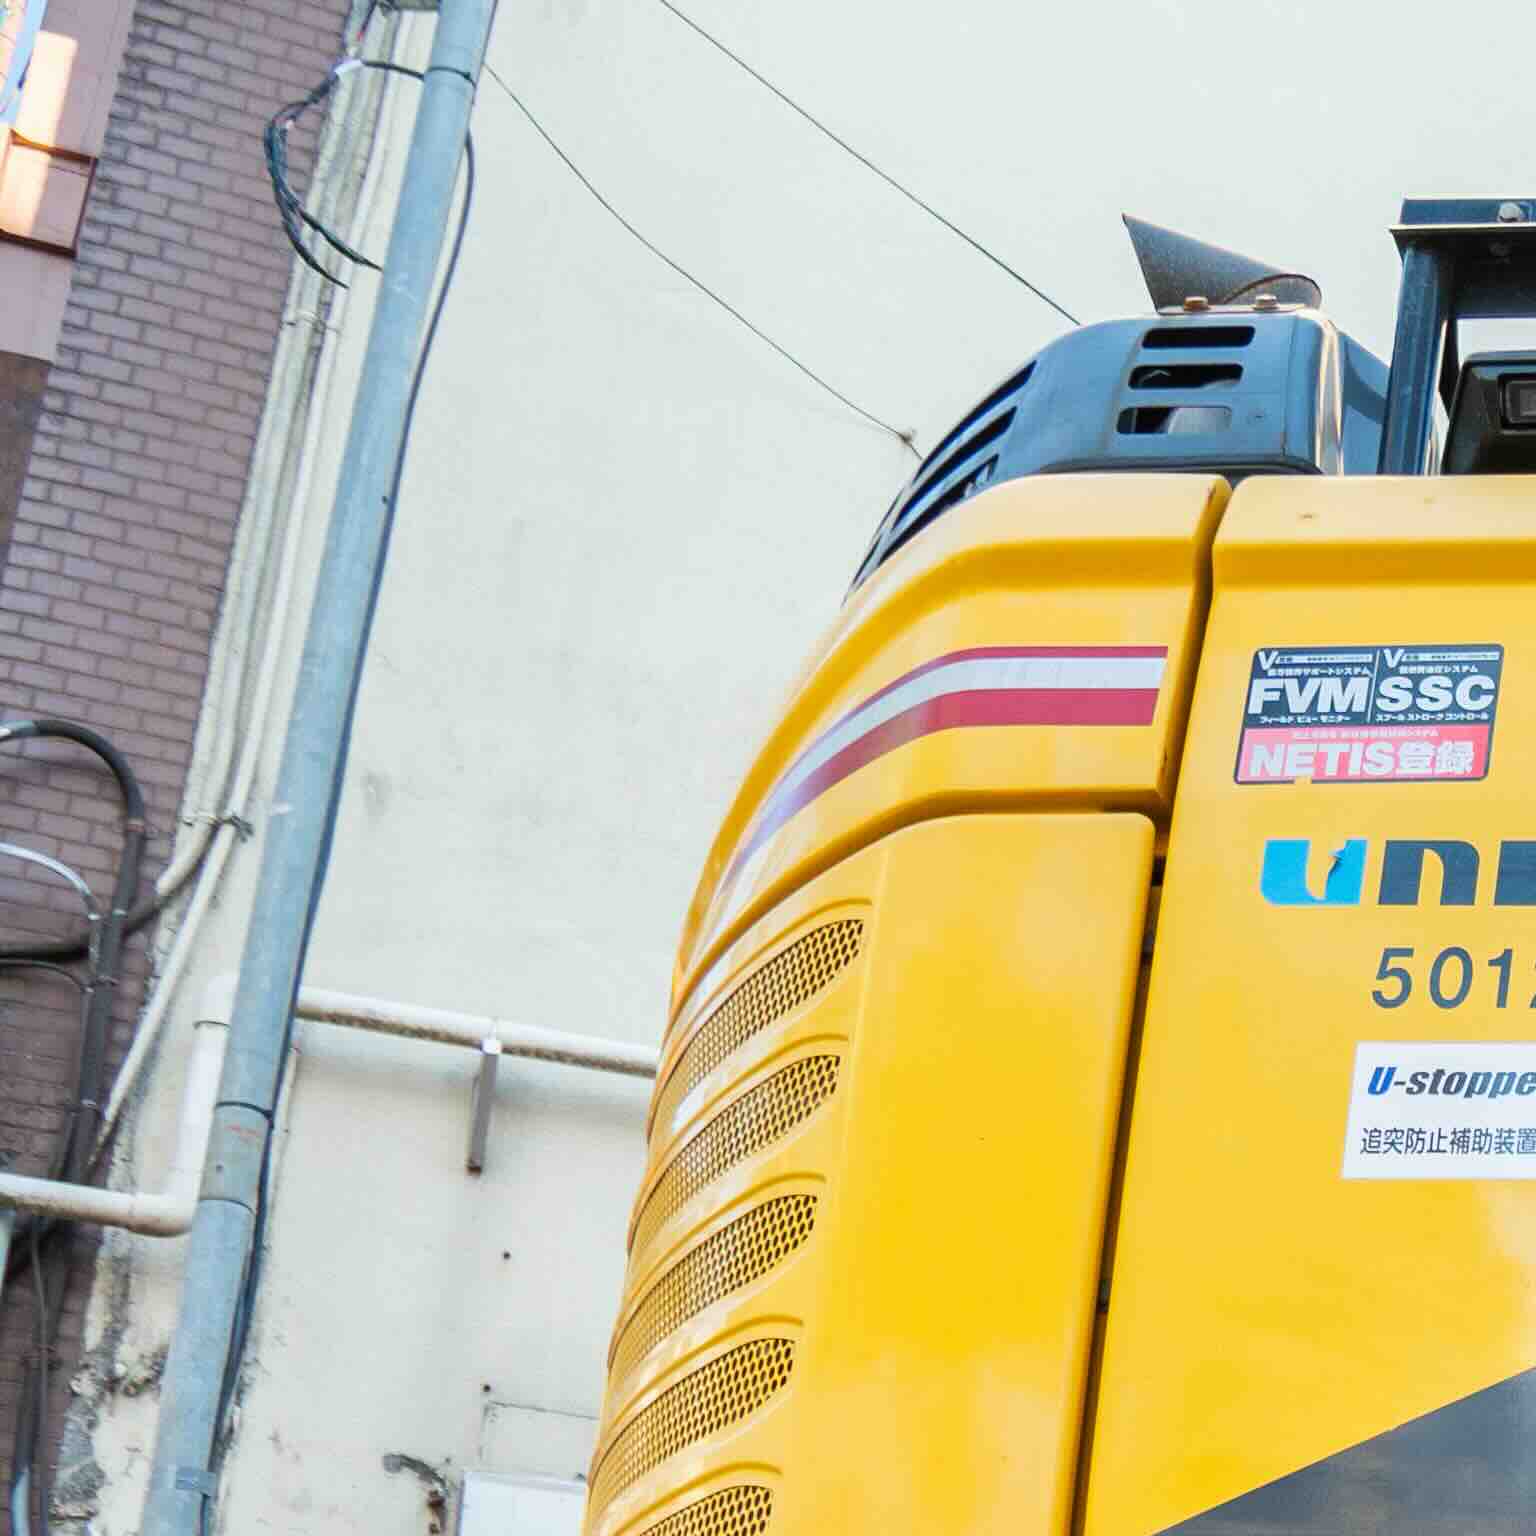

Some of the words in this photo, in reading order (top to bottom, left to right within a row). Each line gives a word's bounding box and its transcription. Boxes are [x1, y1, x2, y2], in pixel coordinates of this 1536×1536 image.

[1247, 677, 1371, 714] FVM
[1375, 674, 1496, 712] SSC
[1248, 740, 1475, 777] NETIS登録
